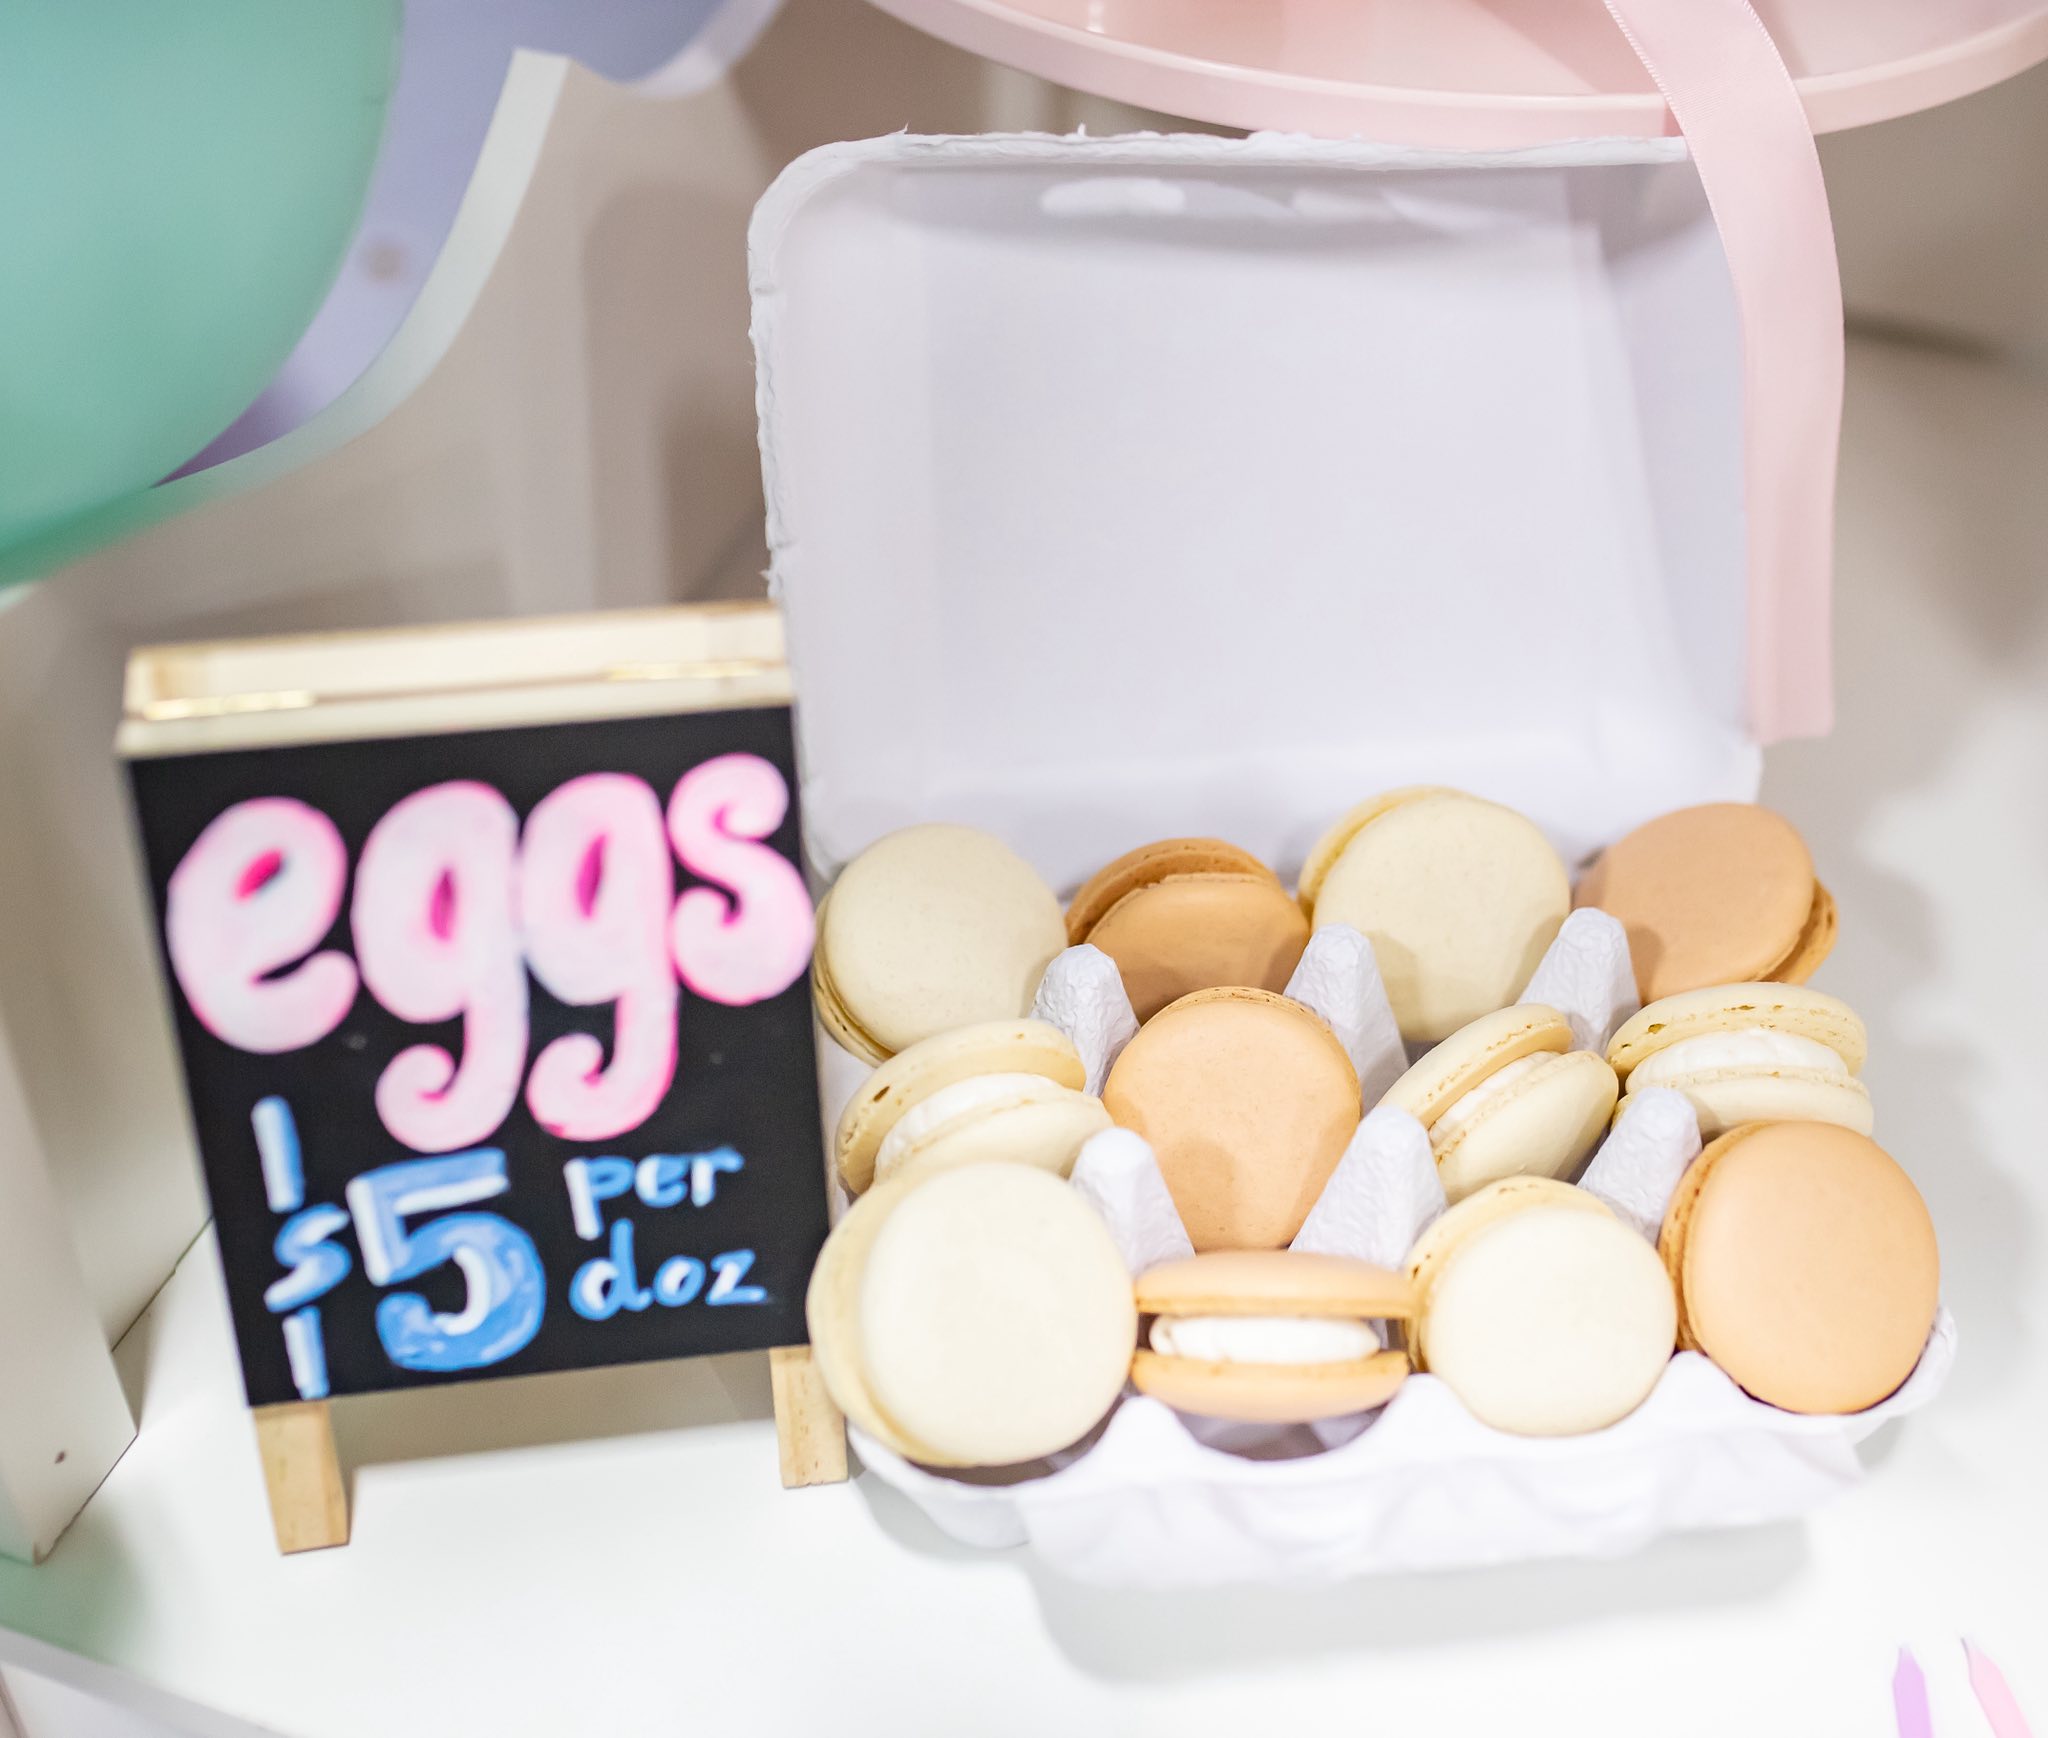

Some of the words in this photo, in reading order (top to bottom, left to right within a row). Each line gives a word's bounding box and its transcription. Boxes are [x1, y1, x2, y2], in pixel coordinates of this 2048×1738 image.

[166, 752, 816, 1152] eggs
[250, 1094, 546, 1400] $5
[564, 1145, 742, 1240] per
[569, 1220, 767, 1320] doz
